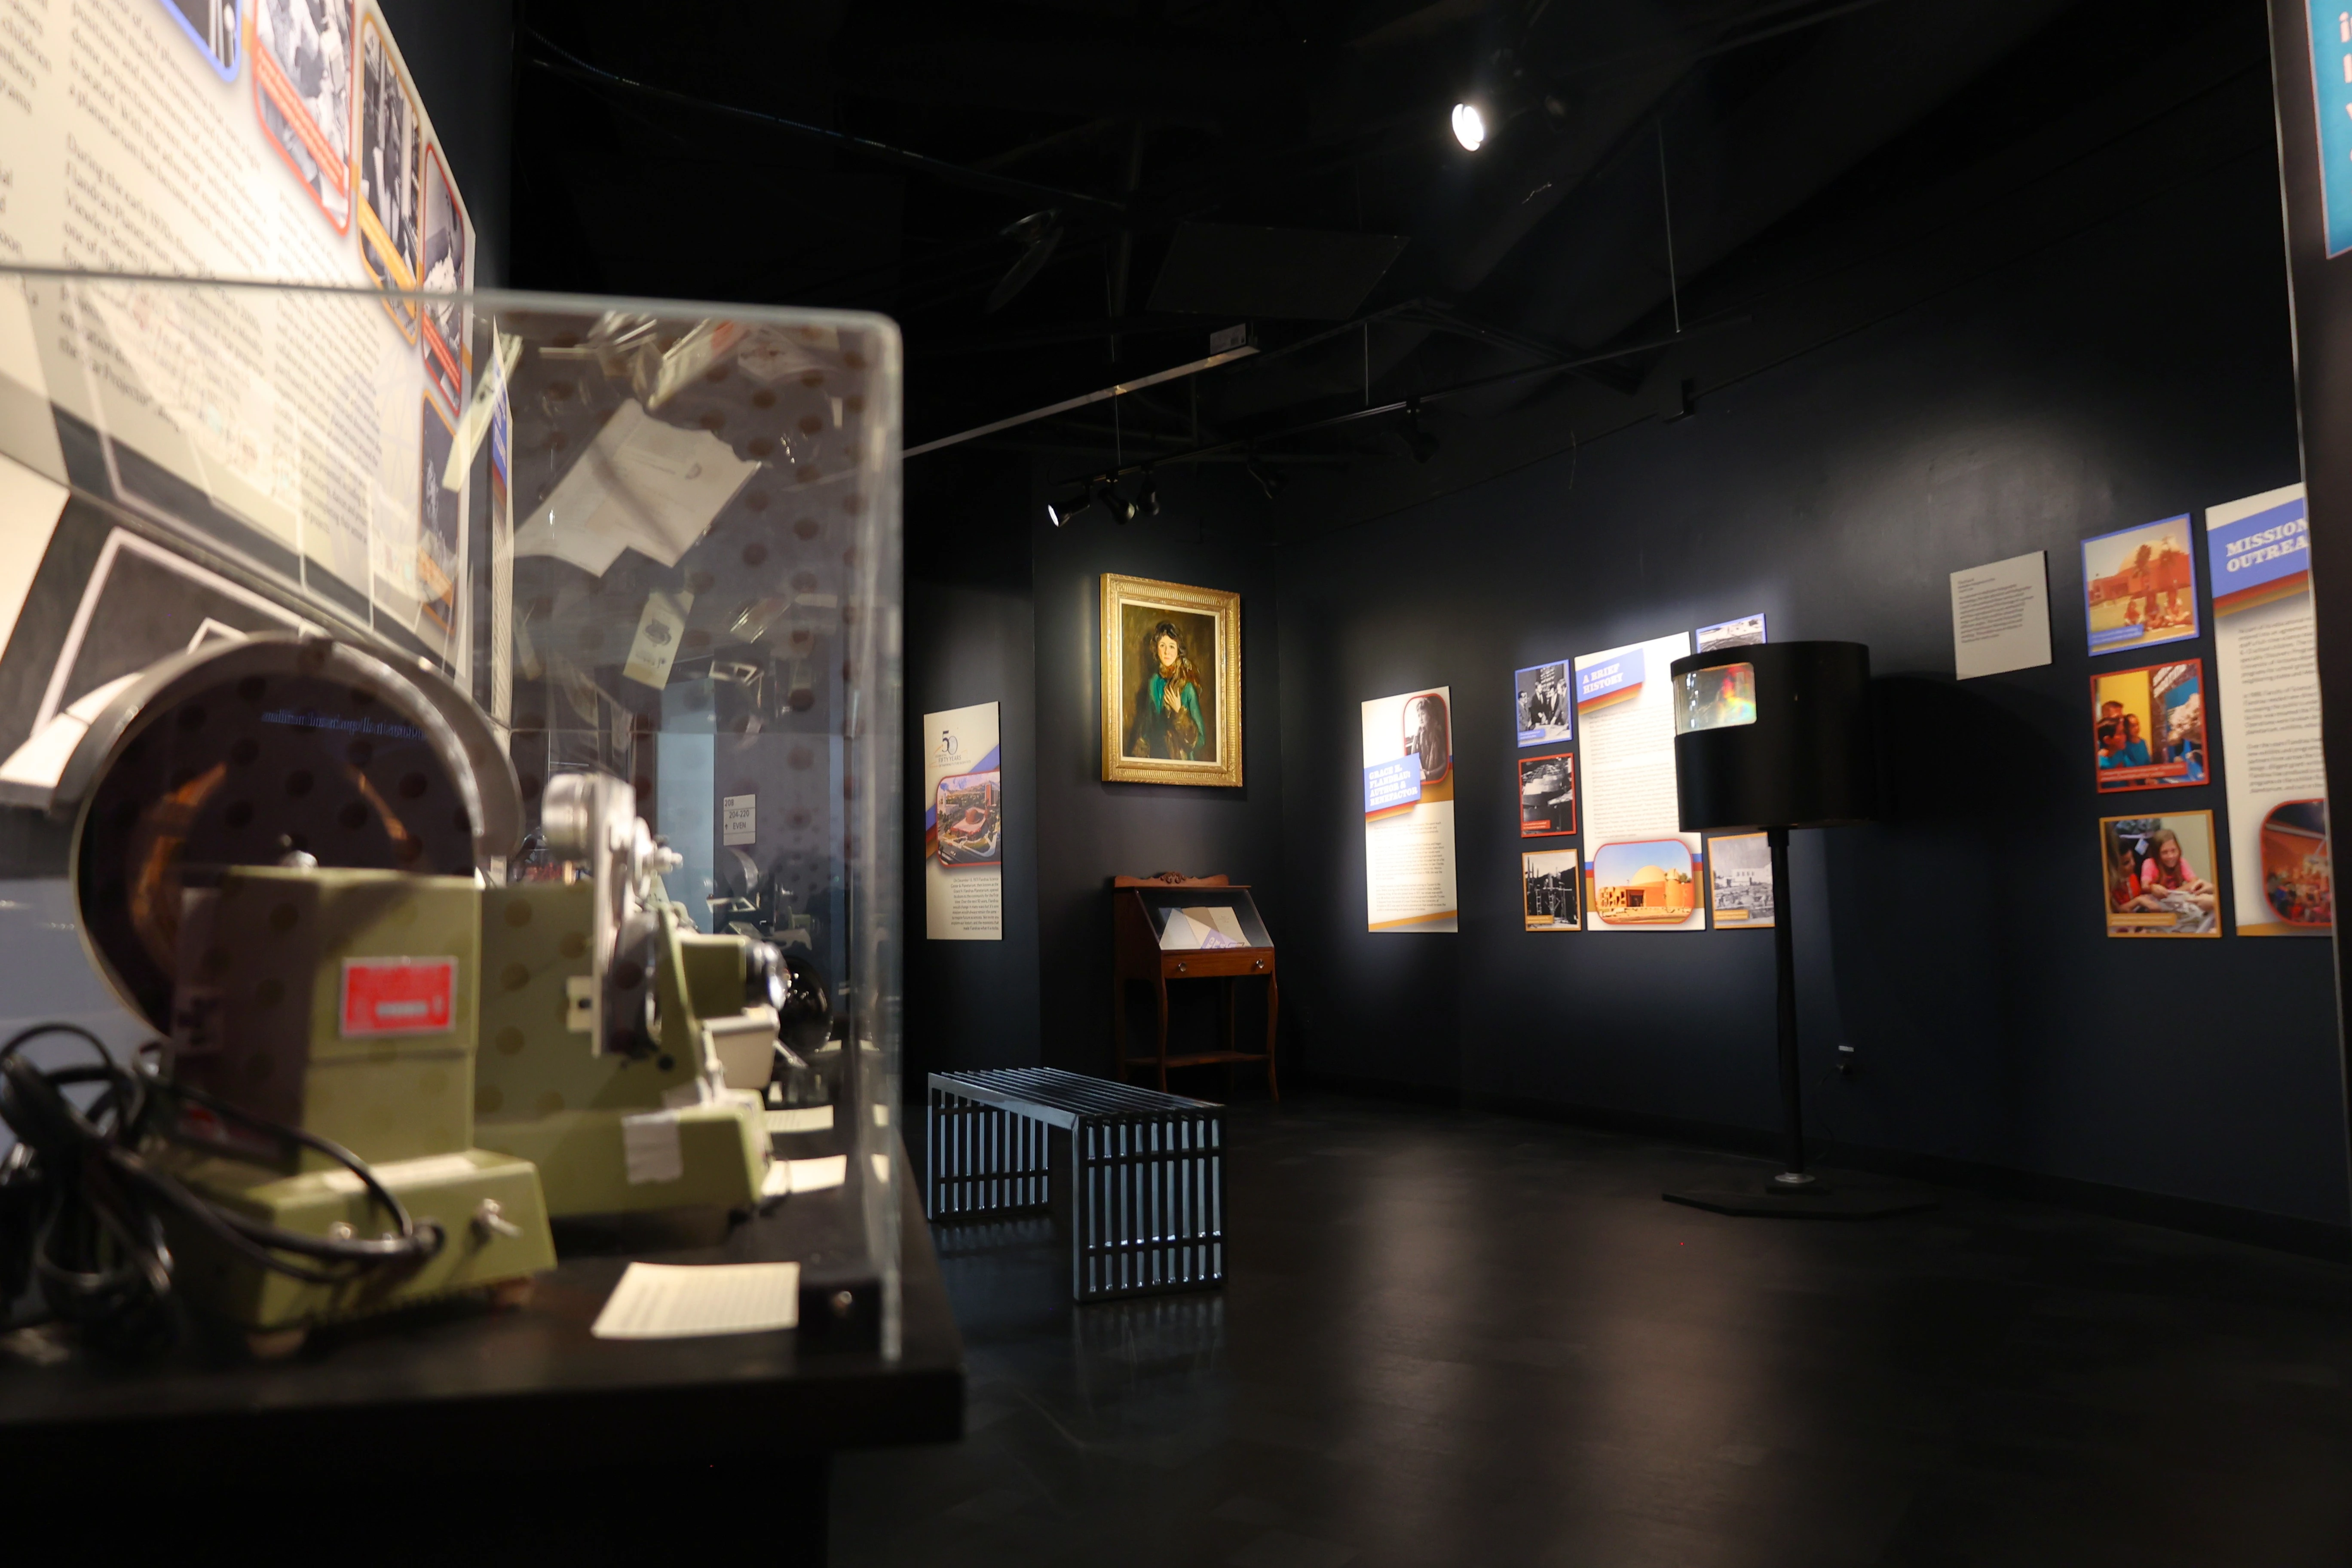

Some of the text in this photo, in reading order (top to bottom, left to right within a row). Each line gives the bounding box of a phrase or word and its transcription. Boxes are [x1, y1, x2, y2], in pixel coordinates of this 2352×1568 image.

[72, 28, 101, 64] dome
[103, 62, 152, 119] projection
[66, 162, 111, 214] Flandrau
[115, 205, 171, 264] Planetarium
[67, 134, 104, 183] During
[107, 173, 122, 196] the
[125, 193, 147, 219] early
[151, 211, 173, 243] 1970s
[177, 236, 208, 279] through
[1582, 663, 1620, 684] A BRIEF
[1583, 672, 1623, 695] HISTORY
[942, 730, 958, 756] 50
[1369, 766, 1393, 780] GRACE
[1370, 783, 1399, 798] AUTHOR
[1370, 787, 1418, 806] BENEFACTOR
[729, 810, 749, 818] 204-220
